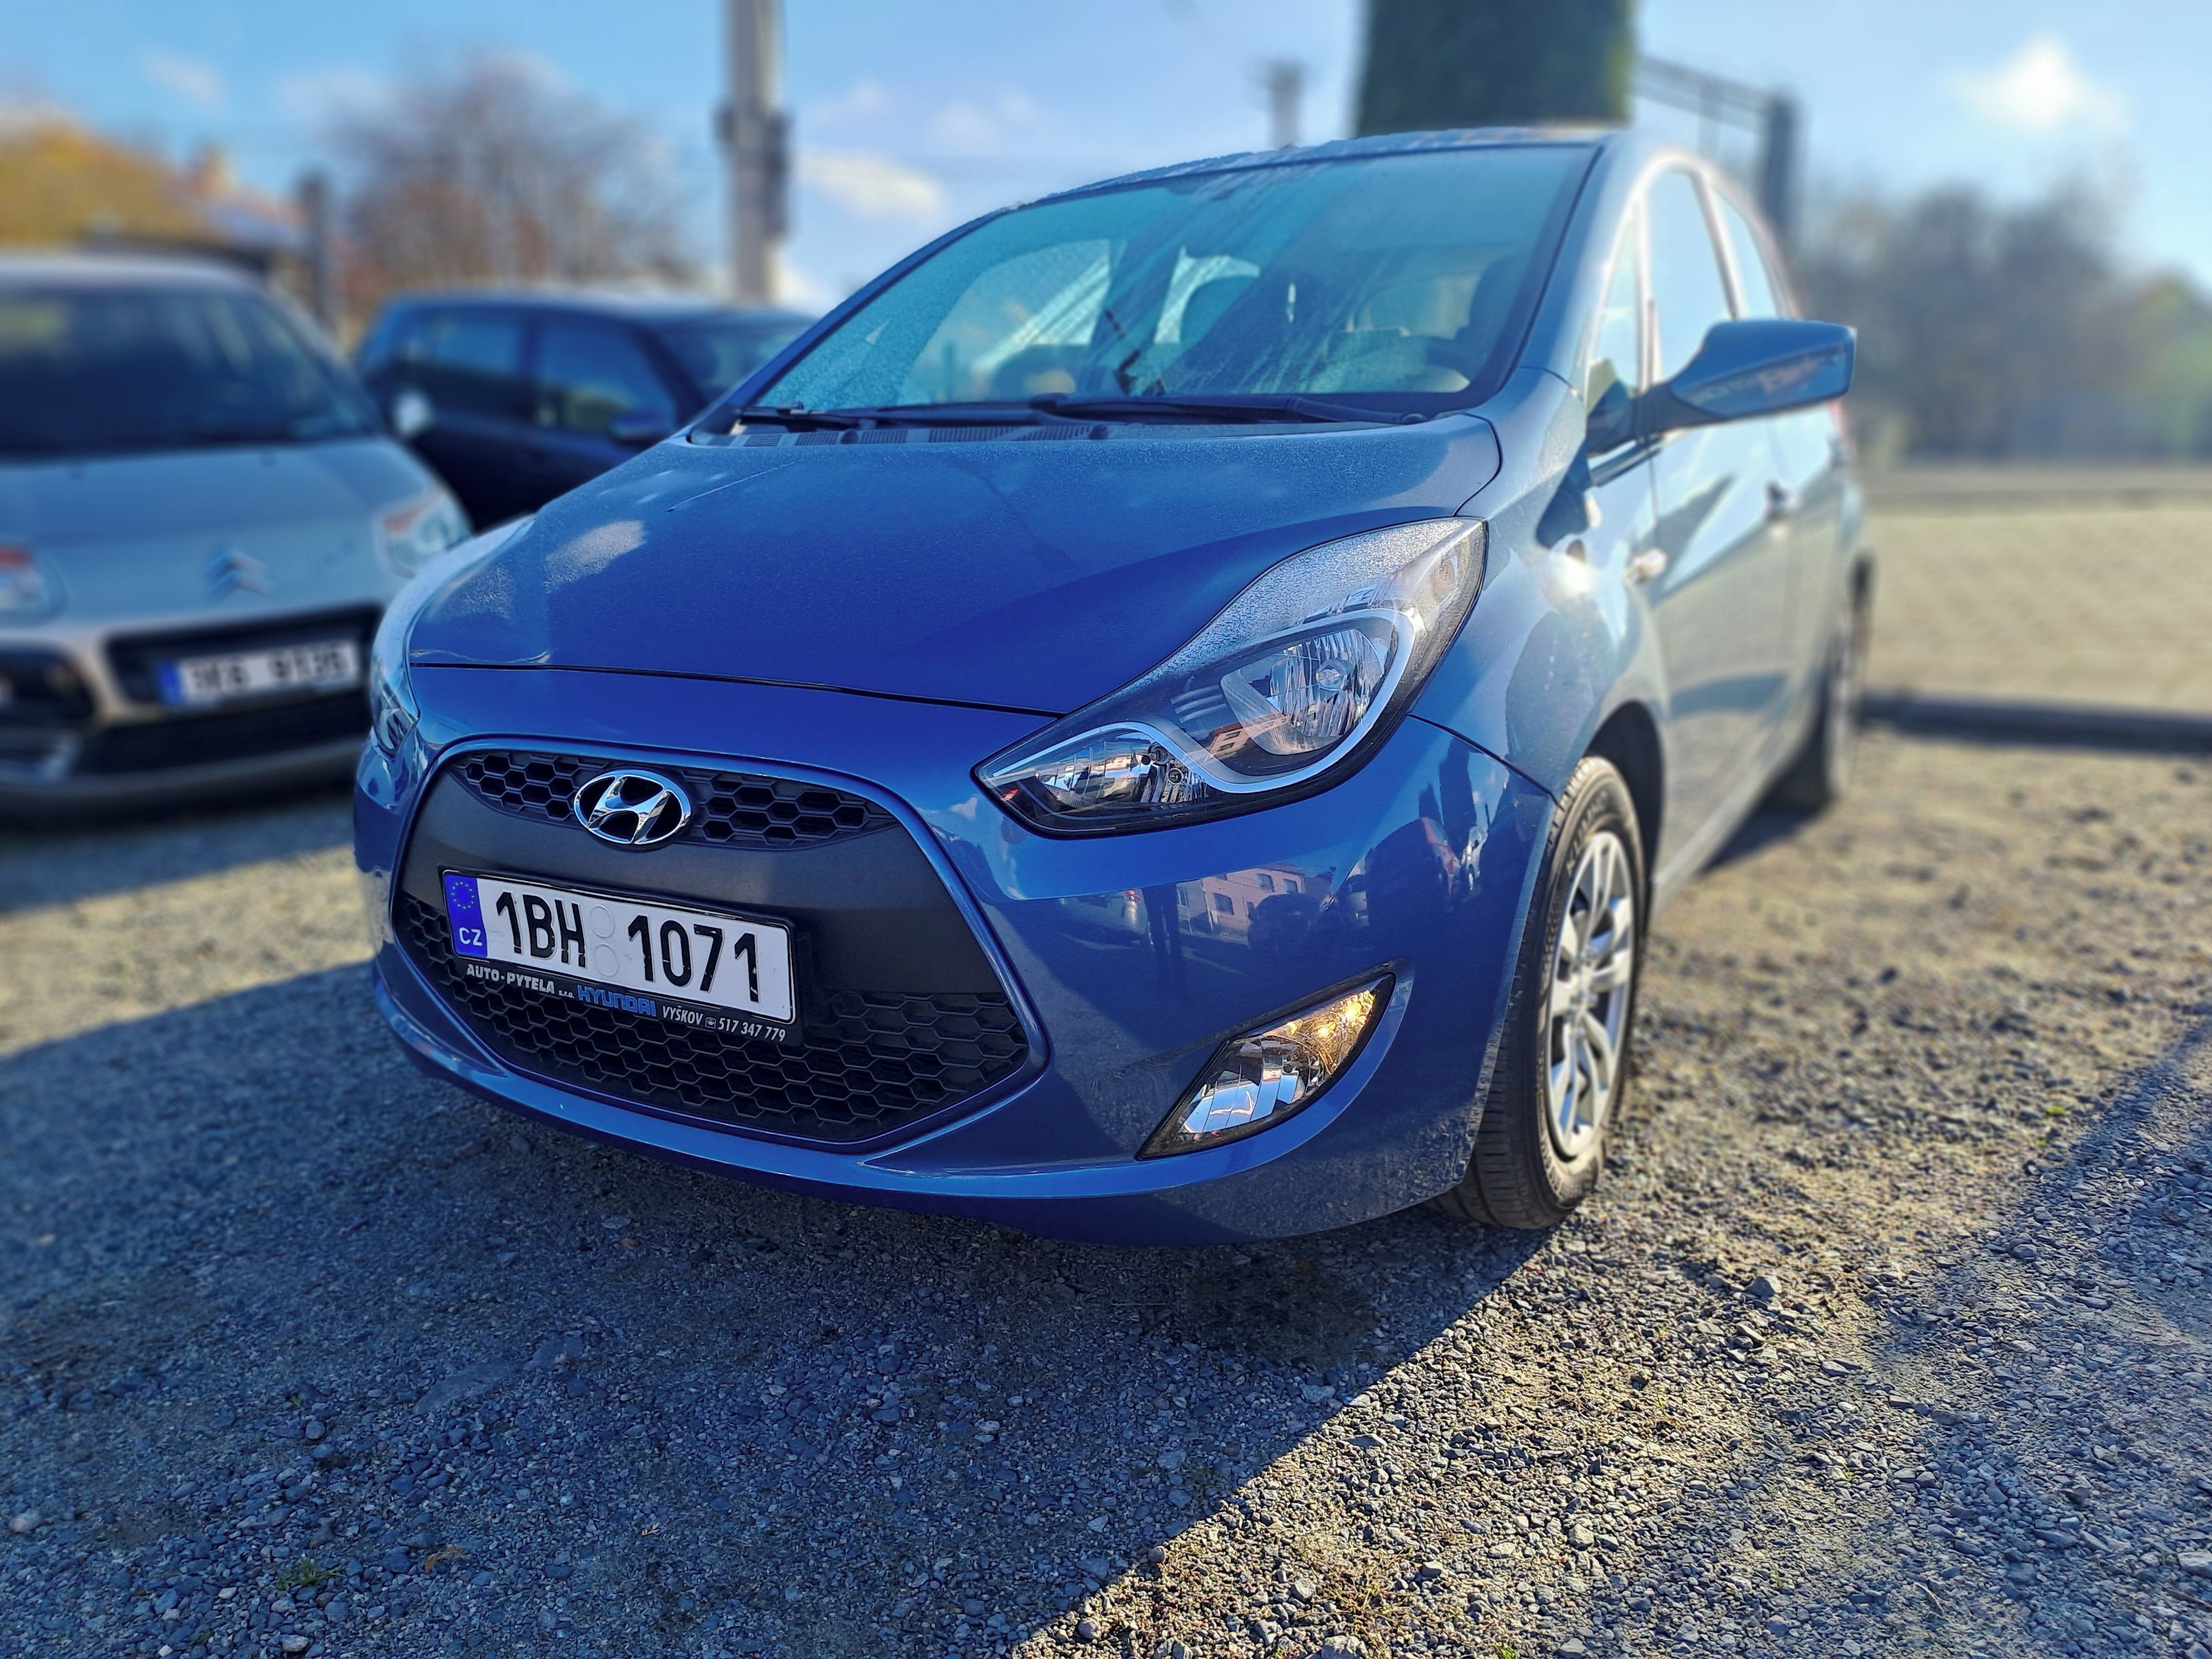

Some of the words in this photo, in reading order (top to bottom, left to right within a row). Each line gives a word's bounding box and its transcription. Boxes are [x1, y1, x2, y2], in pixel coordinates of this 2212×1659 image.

[458, 927, 483, 947] CZ
[495, 891, 586, 968] 1BH
[628, 915, 760, 1003] 1071
[577, 984, 657, 1018] HYUNDAI
[662, 1004, 704, 1026] VYŠKOV
[718, 1017, 739, 1033] 517
[740, 1022, 763, 1037] 347
[764, 1026, 786, 1042] 779
